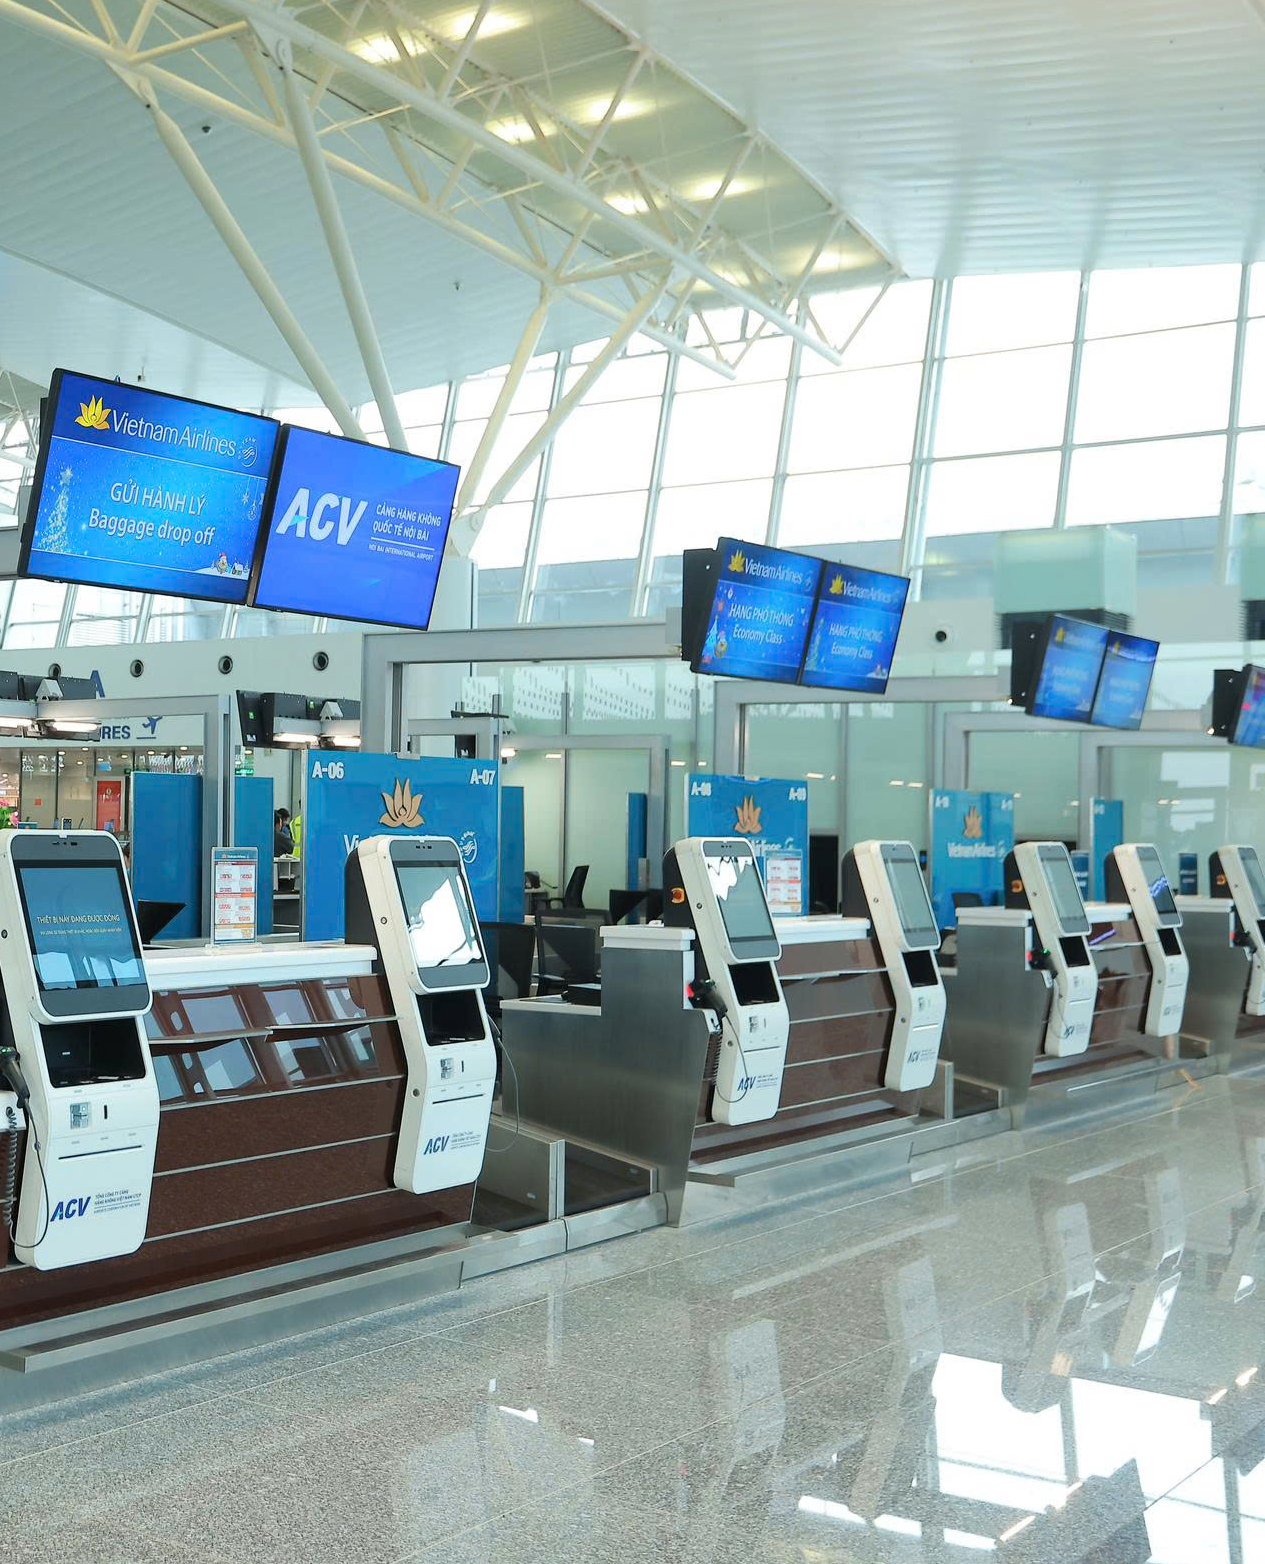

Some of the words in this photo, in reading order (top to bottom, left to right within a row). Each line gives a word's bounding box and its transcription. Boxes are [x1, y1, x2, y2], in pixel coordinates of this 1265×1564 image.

[110, 408, 178, 443] Vietnam
[179, 425, 236, 458] Airlines
[110, 479, 139, 504] GỬI
[141, 484, 188, 512] HÀNH
[189, 493, 206, 516] LÝ
[275, 487, 368, 546] ACV
[376, 502, 396, 518] CẢNG
[397, 507, 417, 521] HÀNG
[417, 512, 441, 527] KHÔNG
[88, 507, 156, 540] Baggage
[158, 515, 194, 545] drop
[195, 524, 217, 547] off
[373, 519, 393, 534] QUỐC
[394, 522, 404, 536] TẾ
[417, 529, 430, 541] BÀI
[744, 558, 775, 578] Vietnam
[733, 624, 765, 645] Economy
[766, 629, 783, 644] Class
[312, 761, 345, 780] A-06
[470, 768, 496, 786] A-07
[424, 1135, 450, 1156] ACV
[50, 1196, 91, 1222] ACV
